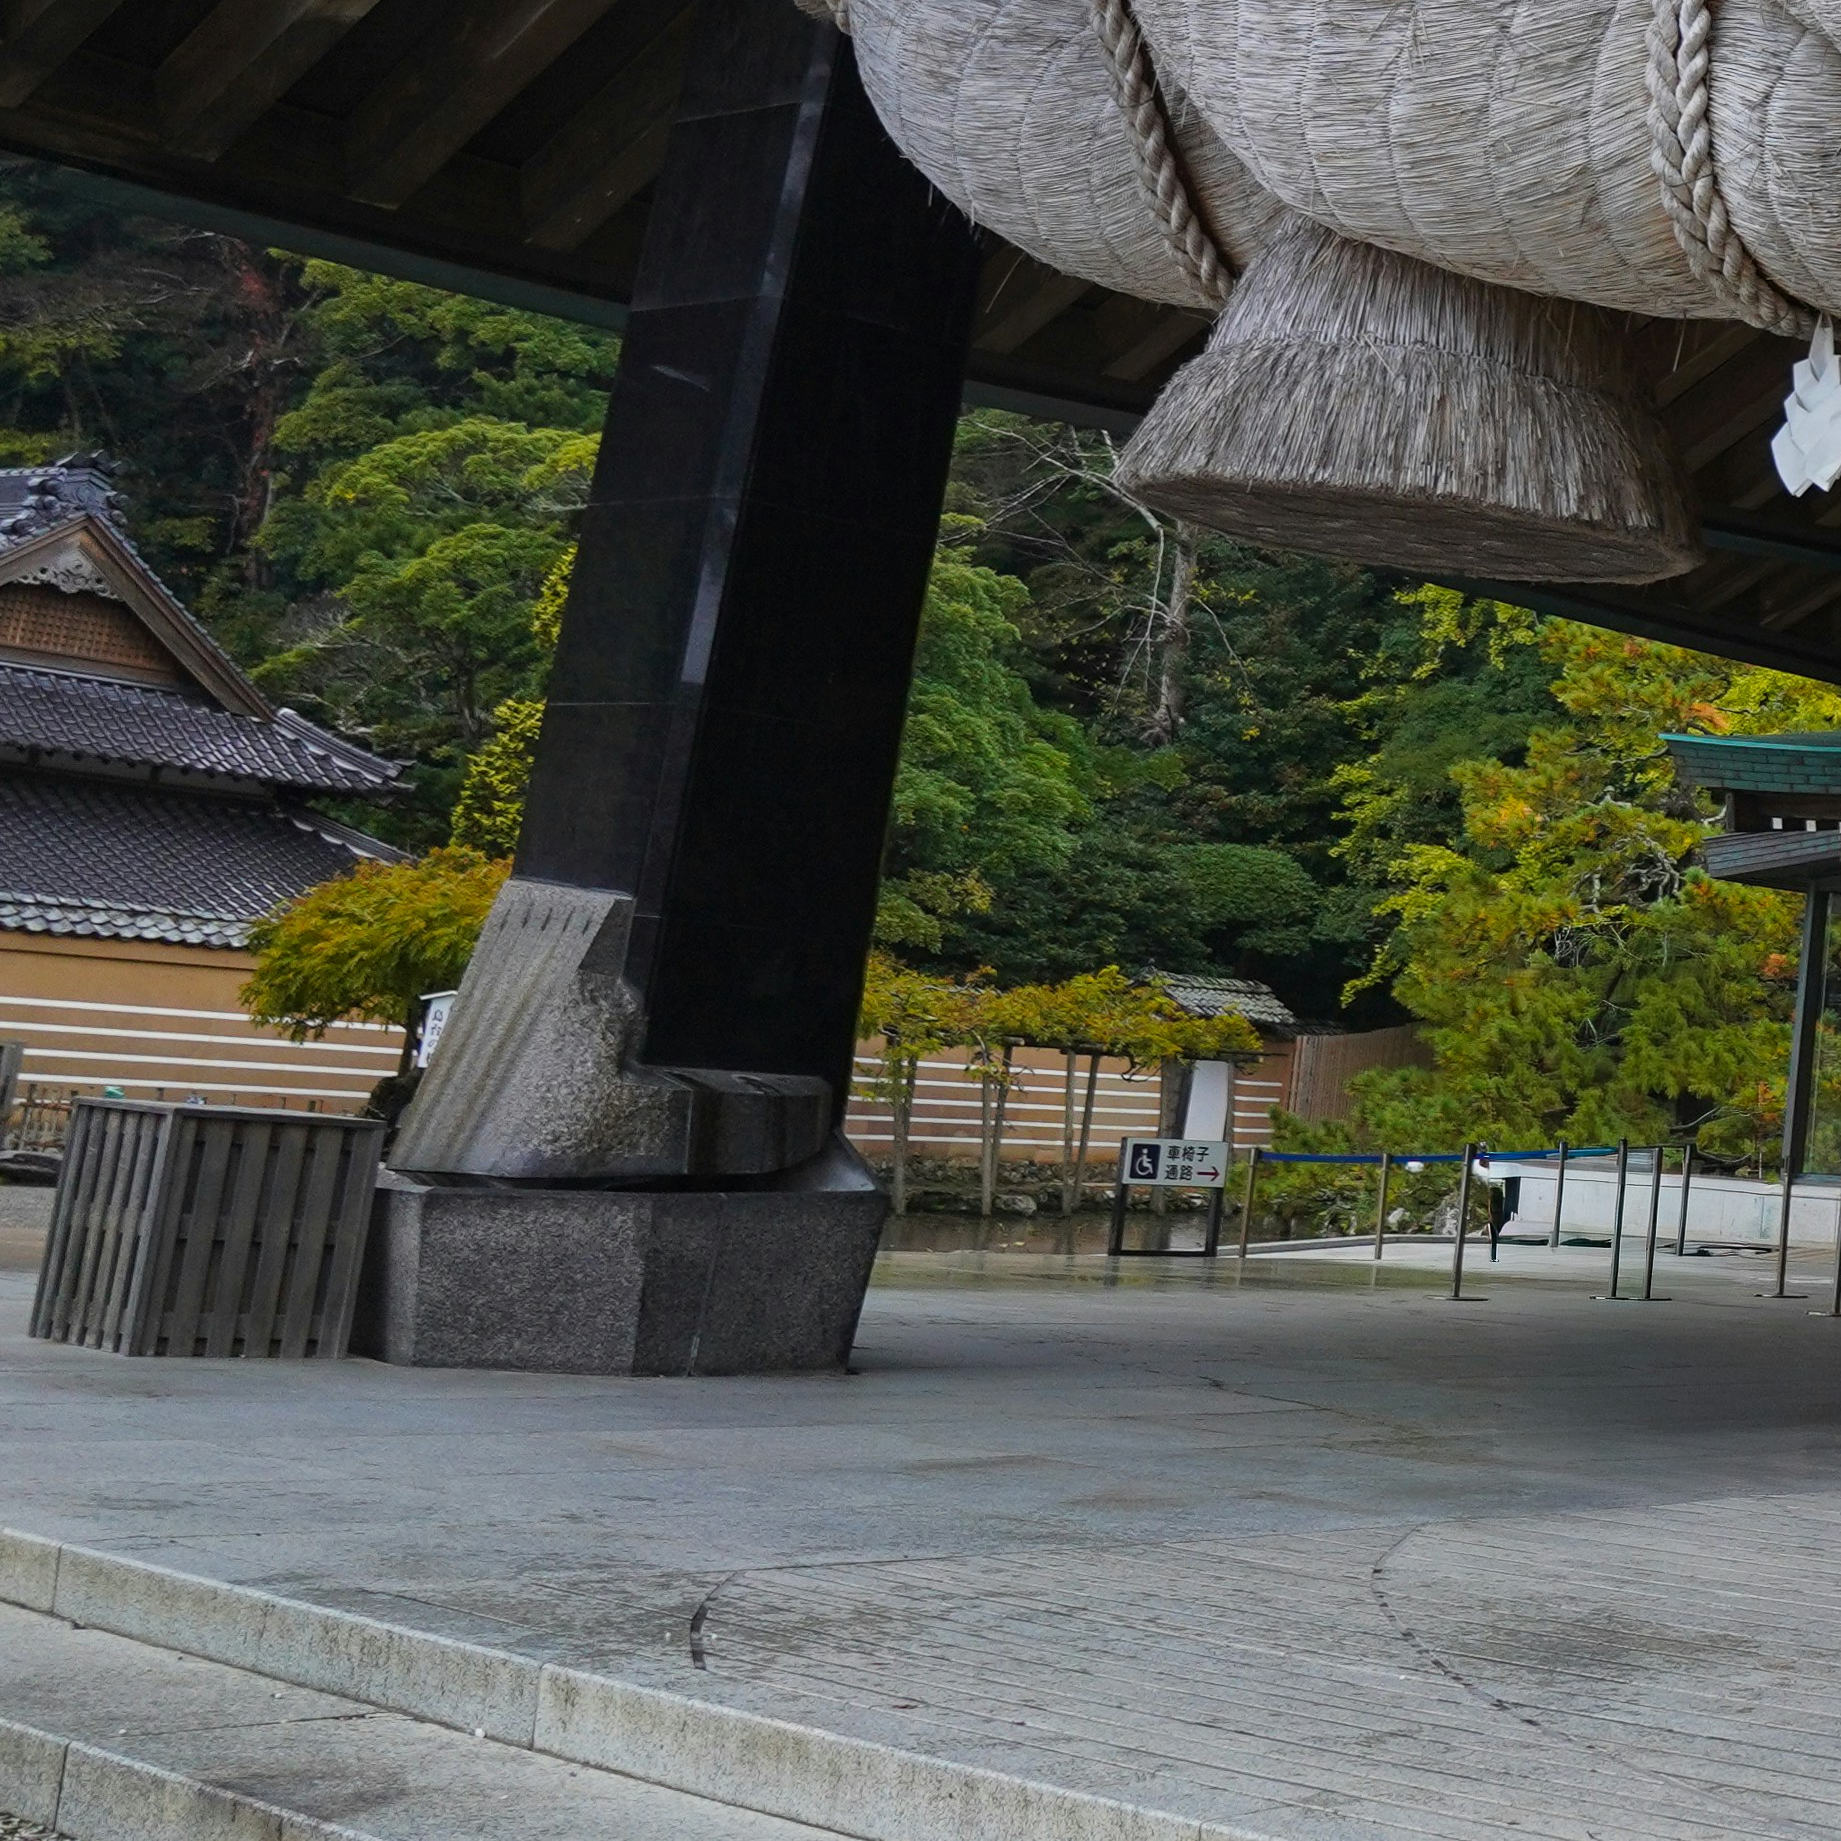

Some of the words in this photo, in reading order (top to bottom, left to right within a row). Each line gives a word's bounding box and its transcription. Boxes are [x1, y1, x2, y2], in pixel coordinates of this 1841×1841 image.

[1166, 1145, 1210, 1163] 車椅子
[1164, 1164, 1193, 1181] 通路
